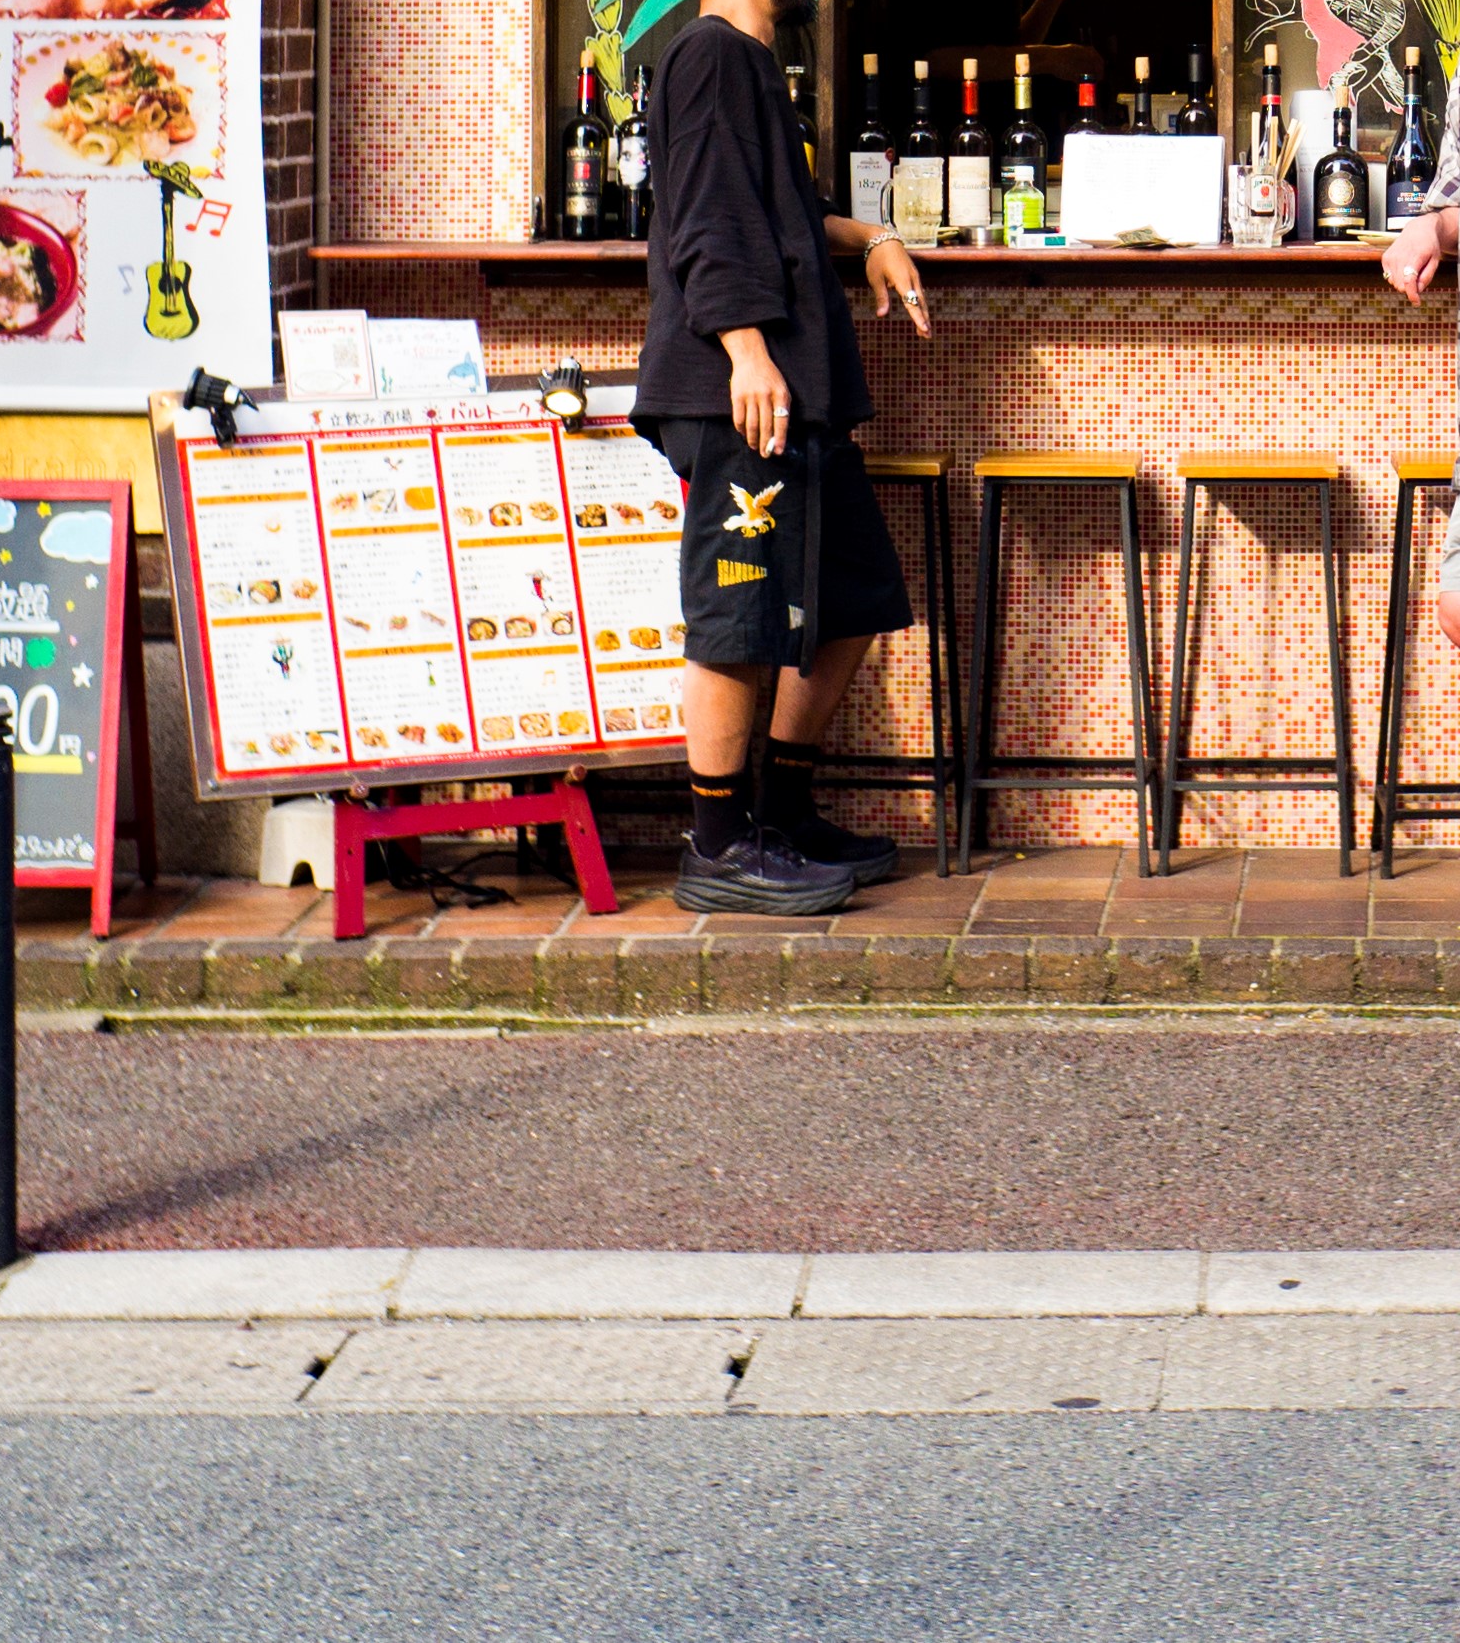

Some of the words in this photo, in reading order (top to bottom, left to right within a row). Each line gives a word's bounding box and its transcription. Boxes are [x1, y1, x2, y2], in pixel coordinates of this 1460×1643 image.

[858, 179, 881, 191] 1827
[330, 408, 413, 426] 立飲み酒場
[450, 401, 532, 420] バルトーク
